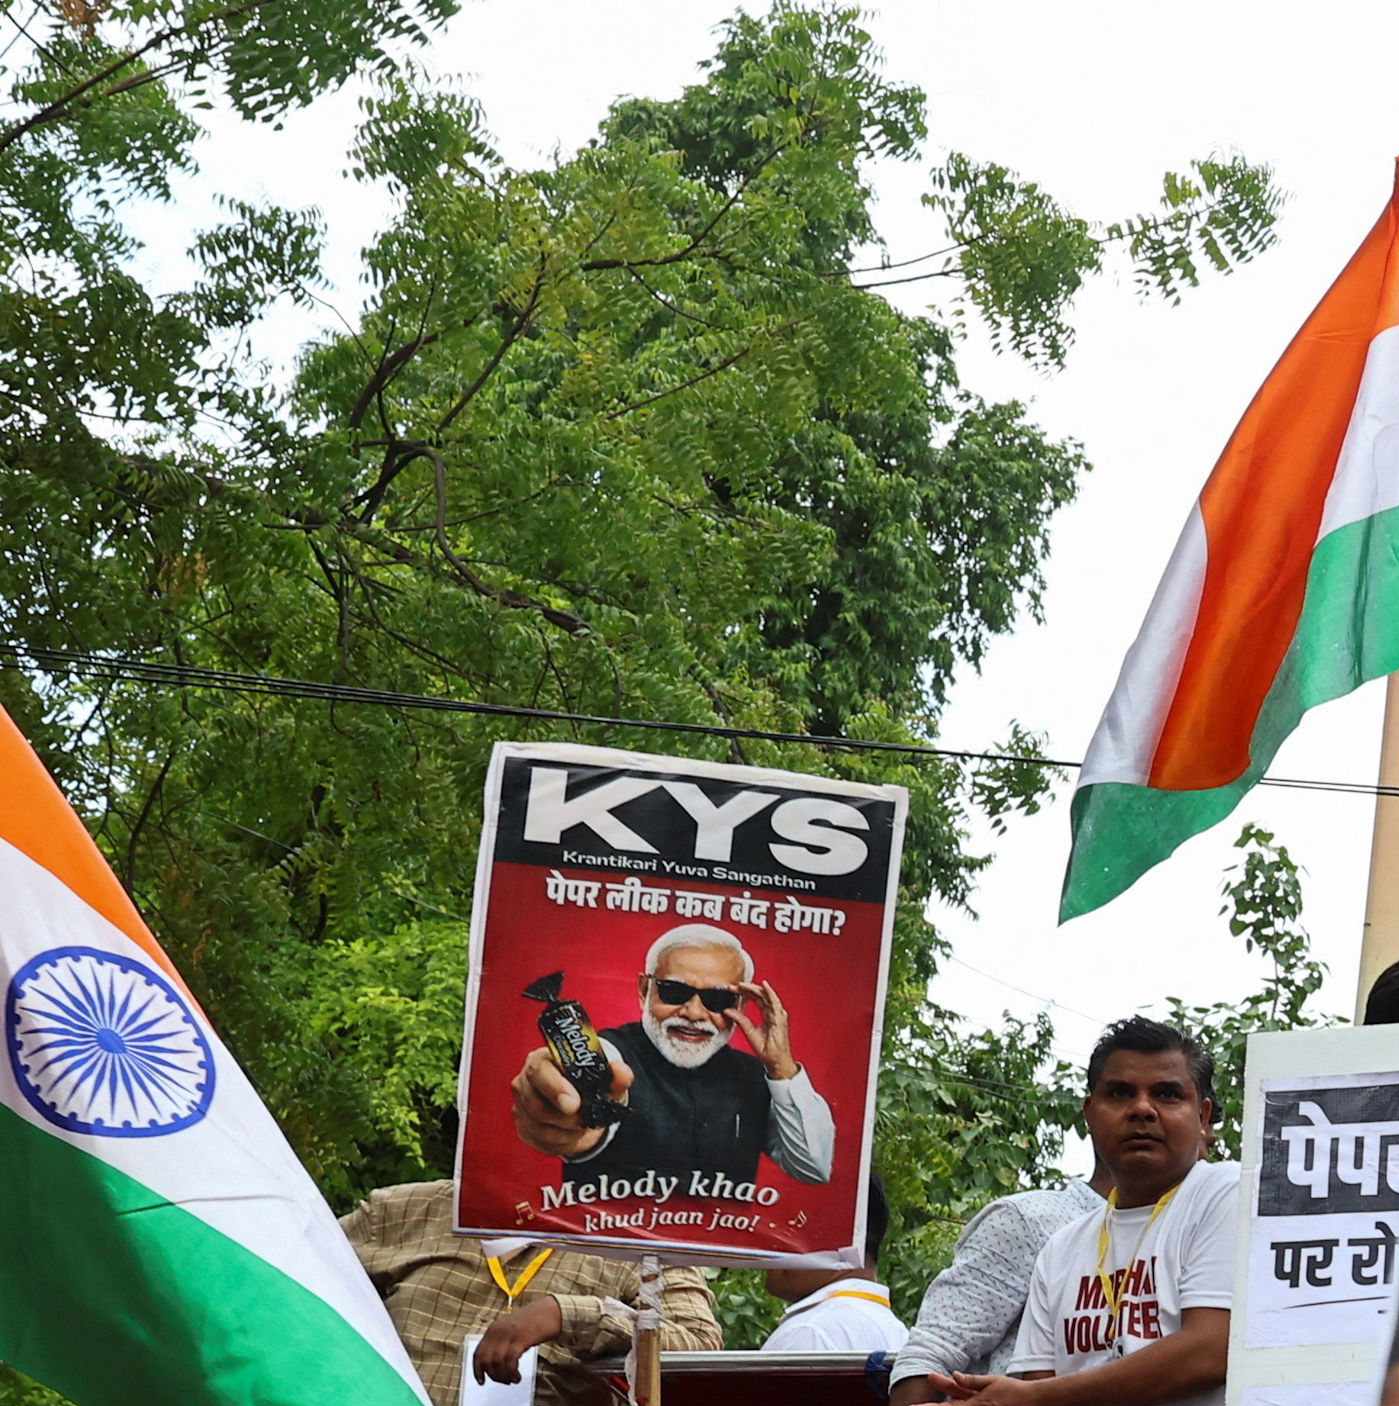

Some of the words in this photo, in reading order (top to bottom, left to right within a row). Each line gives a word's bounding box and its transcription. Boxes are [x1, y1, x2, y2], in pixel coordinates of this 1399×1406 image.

[523, 767, 869, 877] KYS
[563, 850, 658, 872] Krantikari
[661, 860, 708, 878] Yuva
[712, 866, 817, 891] Sangathan
[546, 869, 602, 908] पेपर
[605, 876, 671, 915] लीक
[675, 889, 725, 921] कब
[730, 891, 770, 930] बंद
[773, 895, 846, 937] होगा?
[554, 1017, 598, 1067] Melody
[541, 1170, 679, 1212] Melody
[688, 1170, 781, 1207] khao
[584, 1208, 645, 1233] khud
[650, 1210, 703, 1230] jaan
[706, 1208, 761, 1232] jao!
[1270, 1238, 1339, 1288] पर
